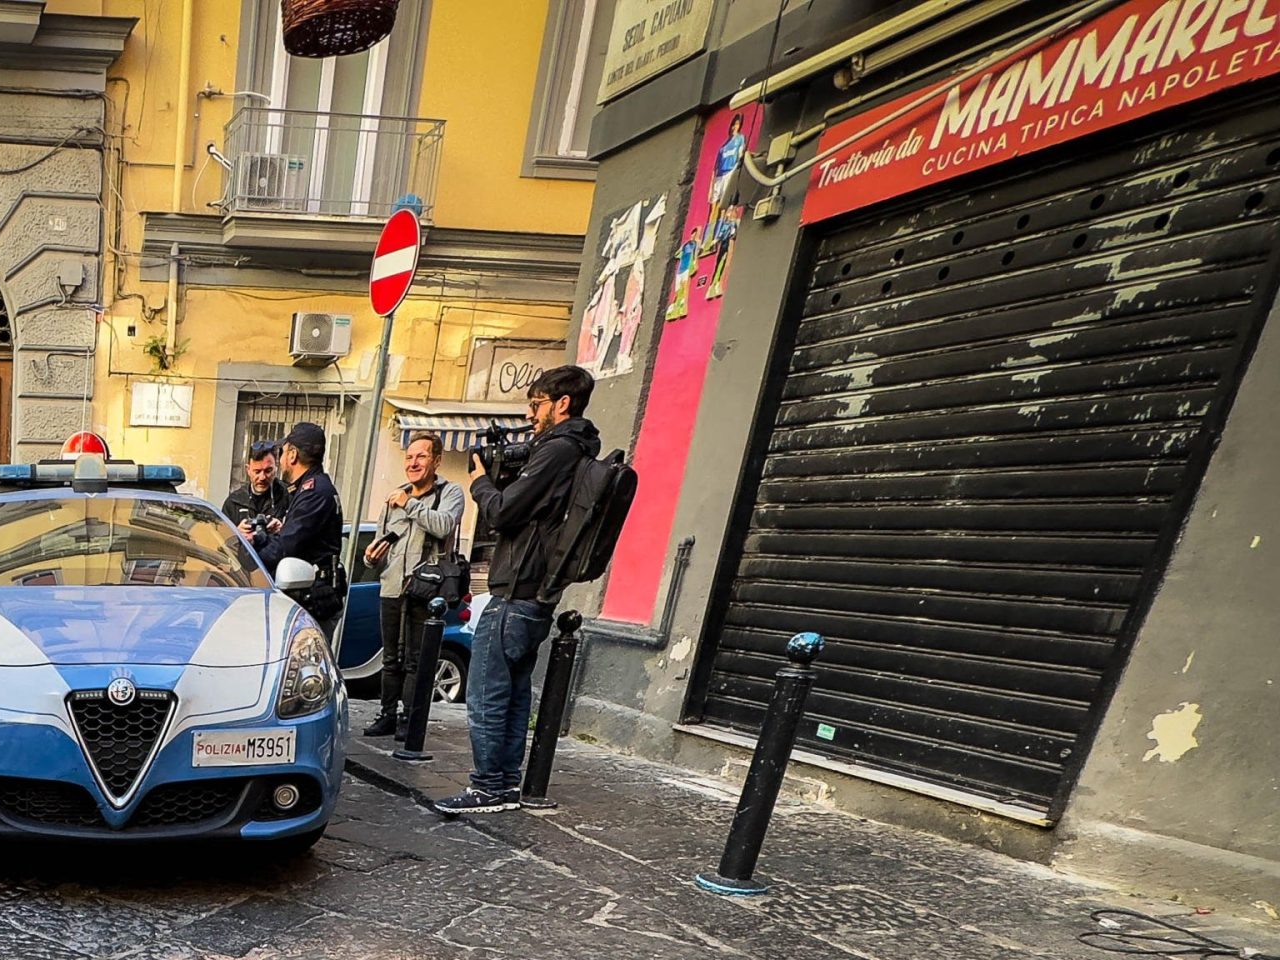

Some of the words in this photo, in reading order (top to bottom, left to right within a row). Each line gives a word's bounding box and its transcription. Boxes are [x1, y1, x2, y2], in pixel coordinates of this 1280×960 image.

[819, 140, 895, 188] Trattoria
[895, 127, 925, 160] da
[922, 132, 1008, 176] CUCINA
[1020, 98, 1104, 144] TIPICA
[196, 740, 240, 755] POLIZIA
[246, 736, 291, 759] M3951
